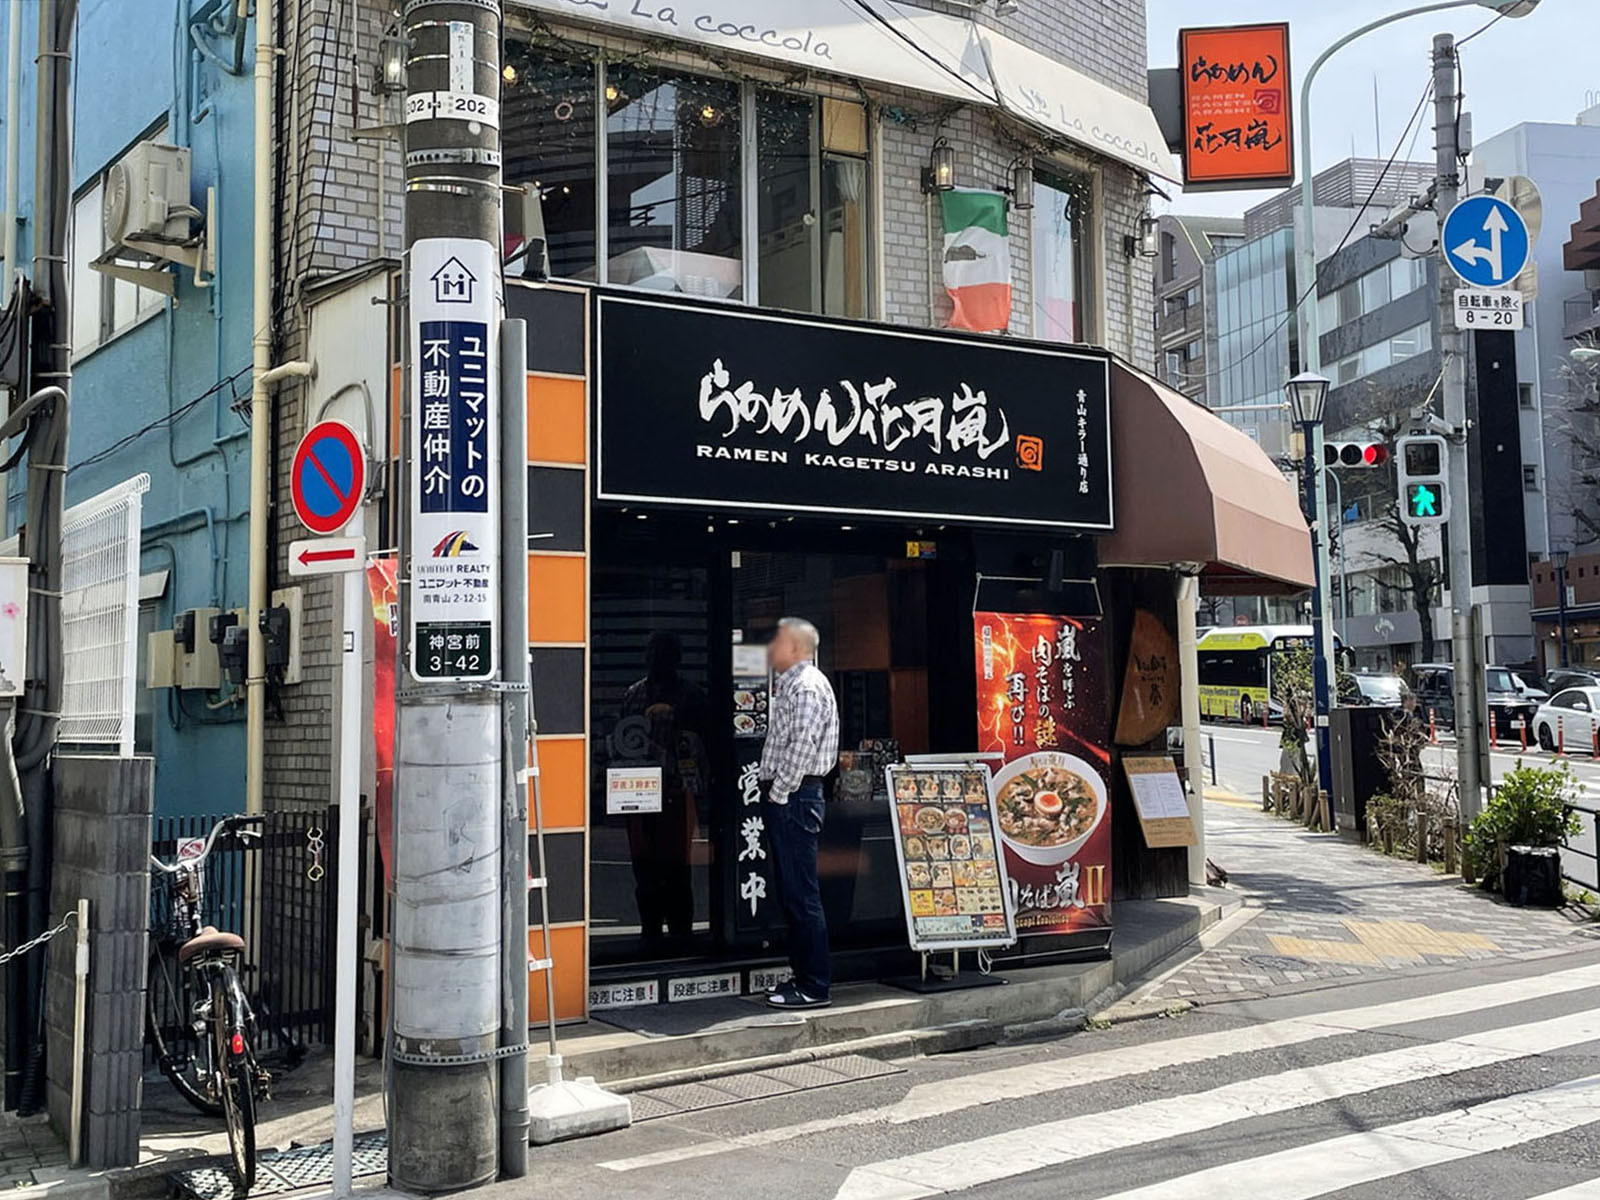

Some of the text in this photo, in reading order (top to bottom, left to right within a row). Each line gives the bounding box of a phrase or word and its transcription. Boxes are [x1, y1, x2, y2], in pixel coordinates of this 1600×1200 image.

[630, 0, 678, 26] La
[455, 98, 486, 114] 202
[1458, 295, 1519, 308] 自転車を除く
[423, 339, 450, 495] 不動産仲介
[459, 336, 485, 497] ユニマットの
[1076, 388, 1089, 493] 青山キラー通り店
[696, 445, 1010, 480] RAMEN KAGETSU ARASHI
[456, 564, 490, 573] REALTY
[429, 634, 480, 650] 神宮前
[430, 655, 479, 671] 3-42
[1054, 624, 1081, 710] 嵐を呼ぶ
[738, 761, 766, 918] 営業中
[673, 976, 737, 997] 段差に注意!
